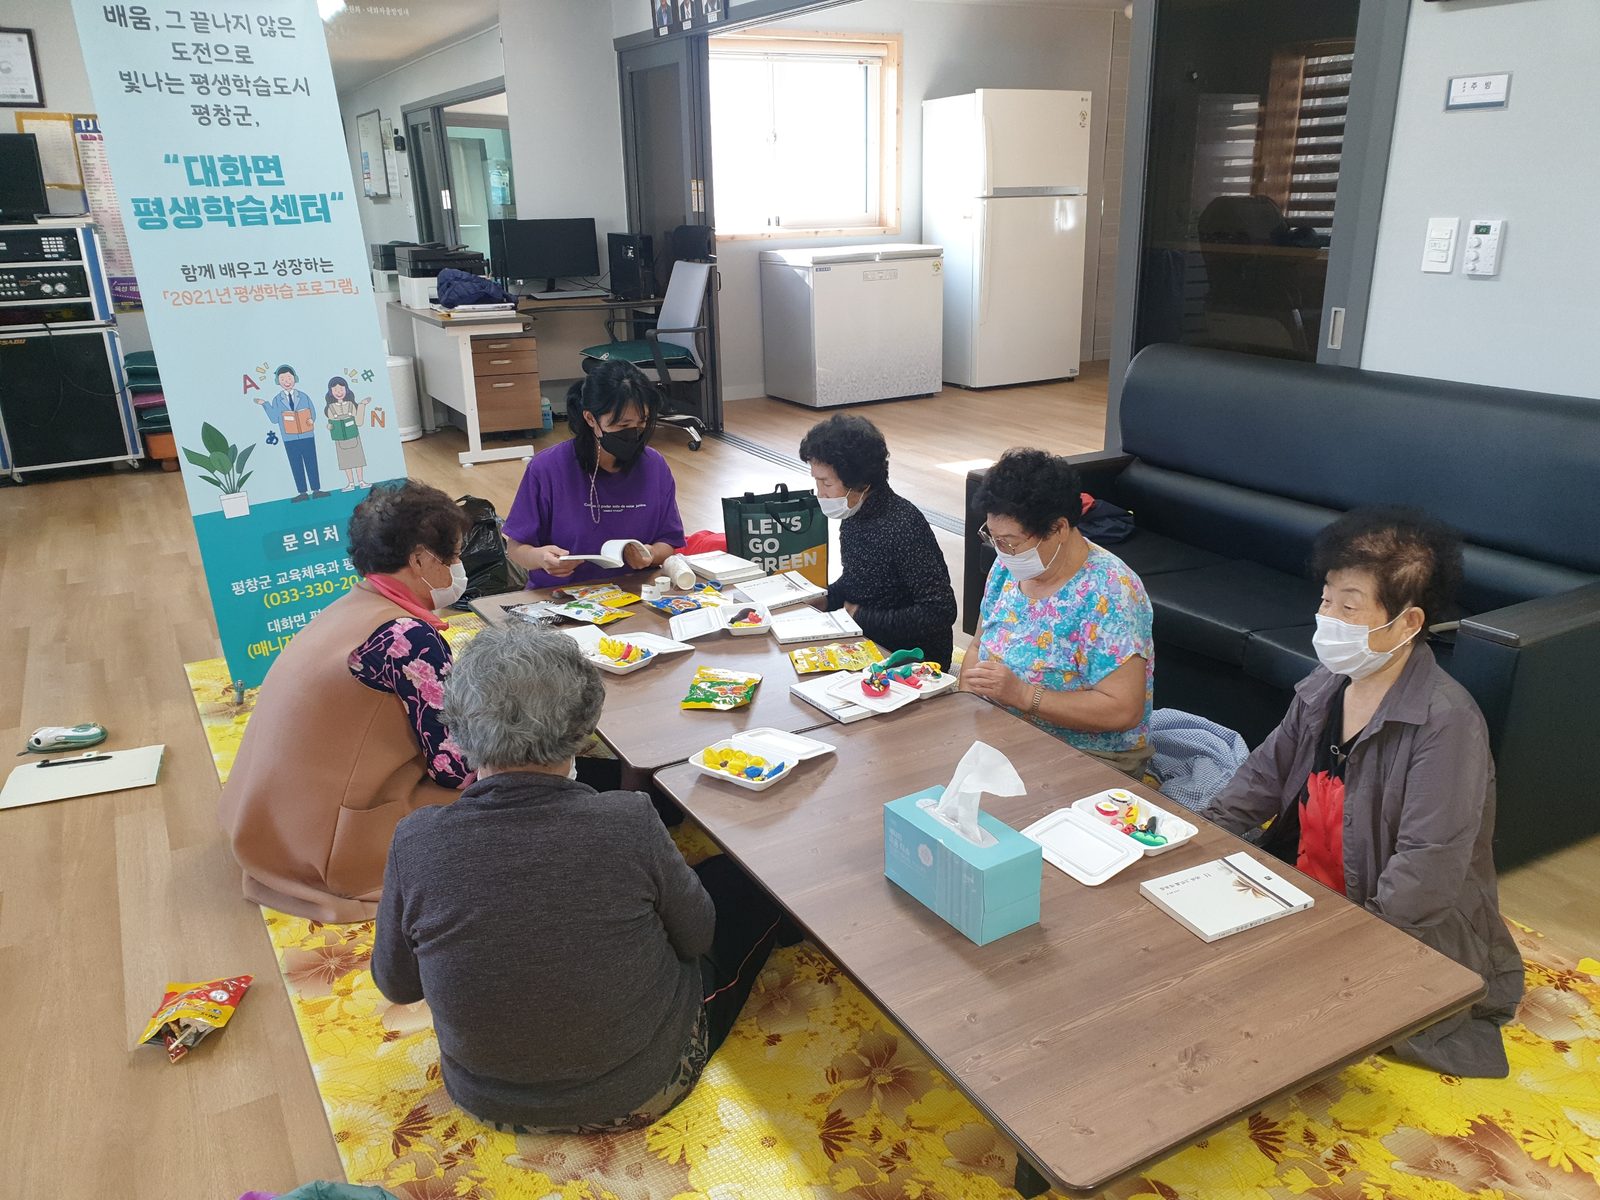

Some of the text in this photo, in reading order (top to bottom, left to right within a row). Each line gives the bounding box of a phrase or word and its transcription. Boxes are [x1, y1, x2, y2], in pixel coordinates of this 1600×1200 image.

[103, 4, 296, 39] 배움, 그 끝나지 않은
[171, 42, 254, 65] 도전으로
[118, 70, 311, 97] 빛나는 평생학습도시
[190, 103, 260, 127] 평창군,
[180, 257, 334, 283] 함께 배우고 성장하는
[234, 283, 294, 304] 평생학습
[242, 374, 261, 394] A
[748, 537, 780, 554] GO
[231, 575, 272, 596] 평창군
[276, 560, 340, 585] 교육체육과
[267, 612, 307, 633] 대화면
